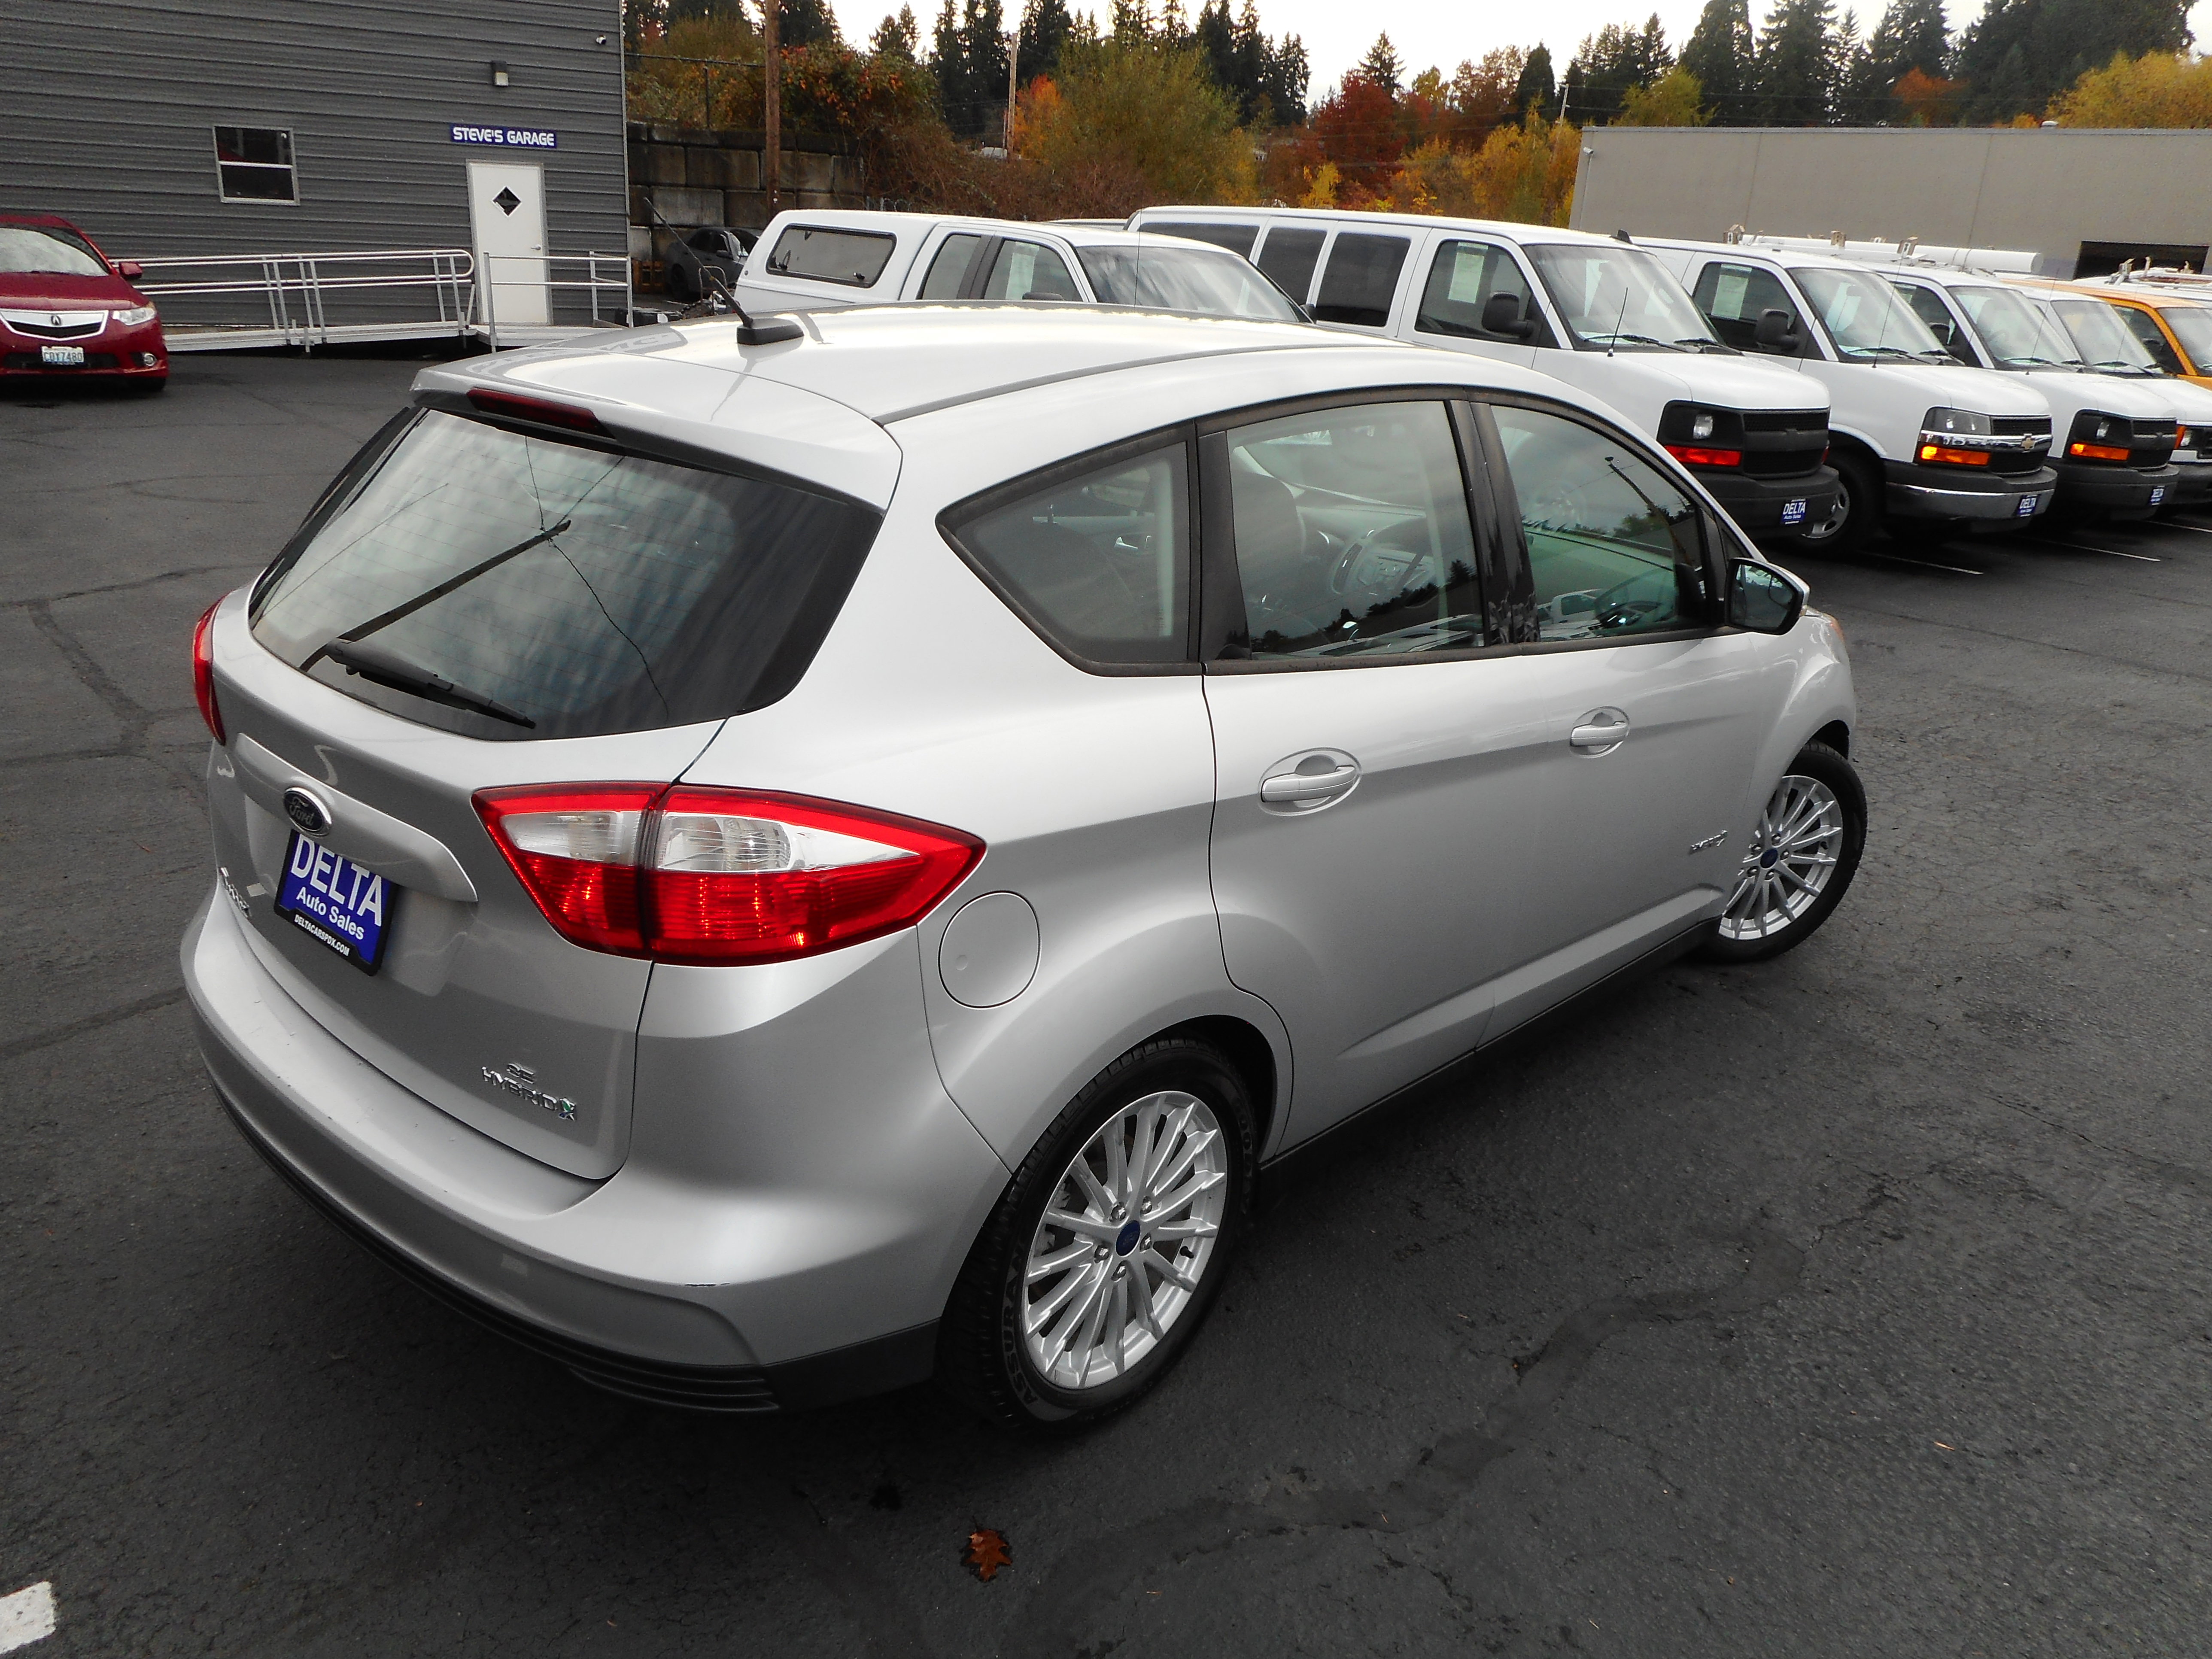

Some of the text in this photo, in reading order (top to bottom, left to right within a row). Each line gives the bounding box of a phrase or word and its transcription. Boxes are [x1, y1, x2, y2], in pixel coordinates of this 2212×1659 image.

[453, 127, 555, 146] STEVE'S GARAGE
[1783, 502, 1806, 515] DELTA
[289, 796, 315, 826] Ford
[291, 833, 382, 927] DELTA
[296, 886, 365, 940] Auto Sales
[294, 914, 350, 957] DELTACARSPDX.COM
[481, 1066, 558, 1111] HYBRID
